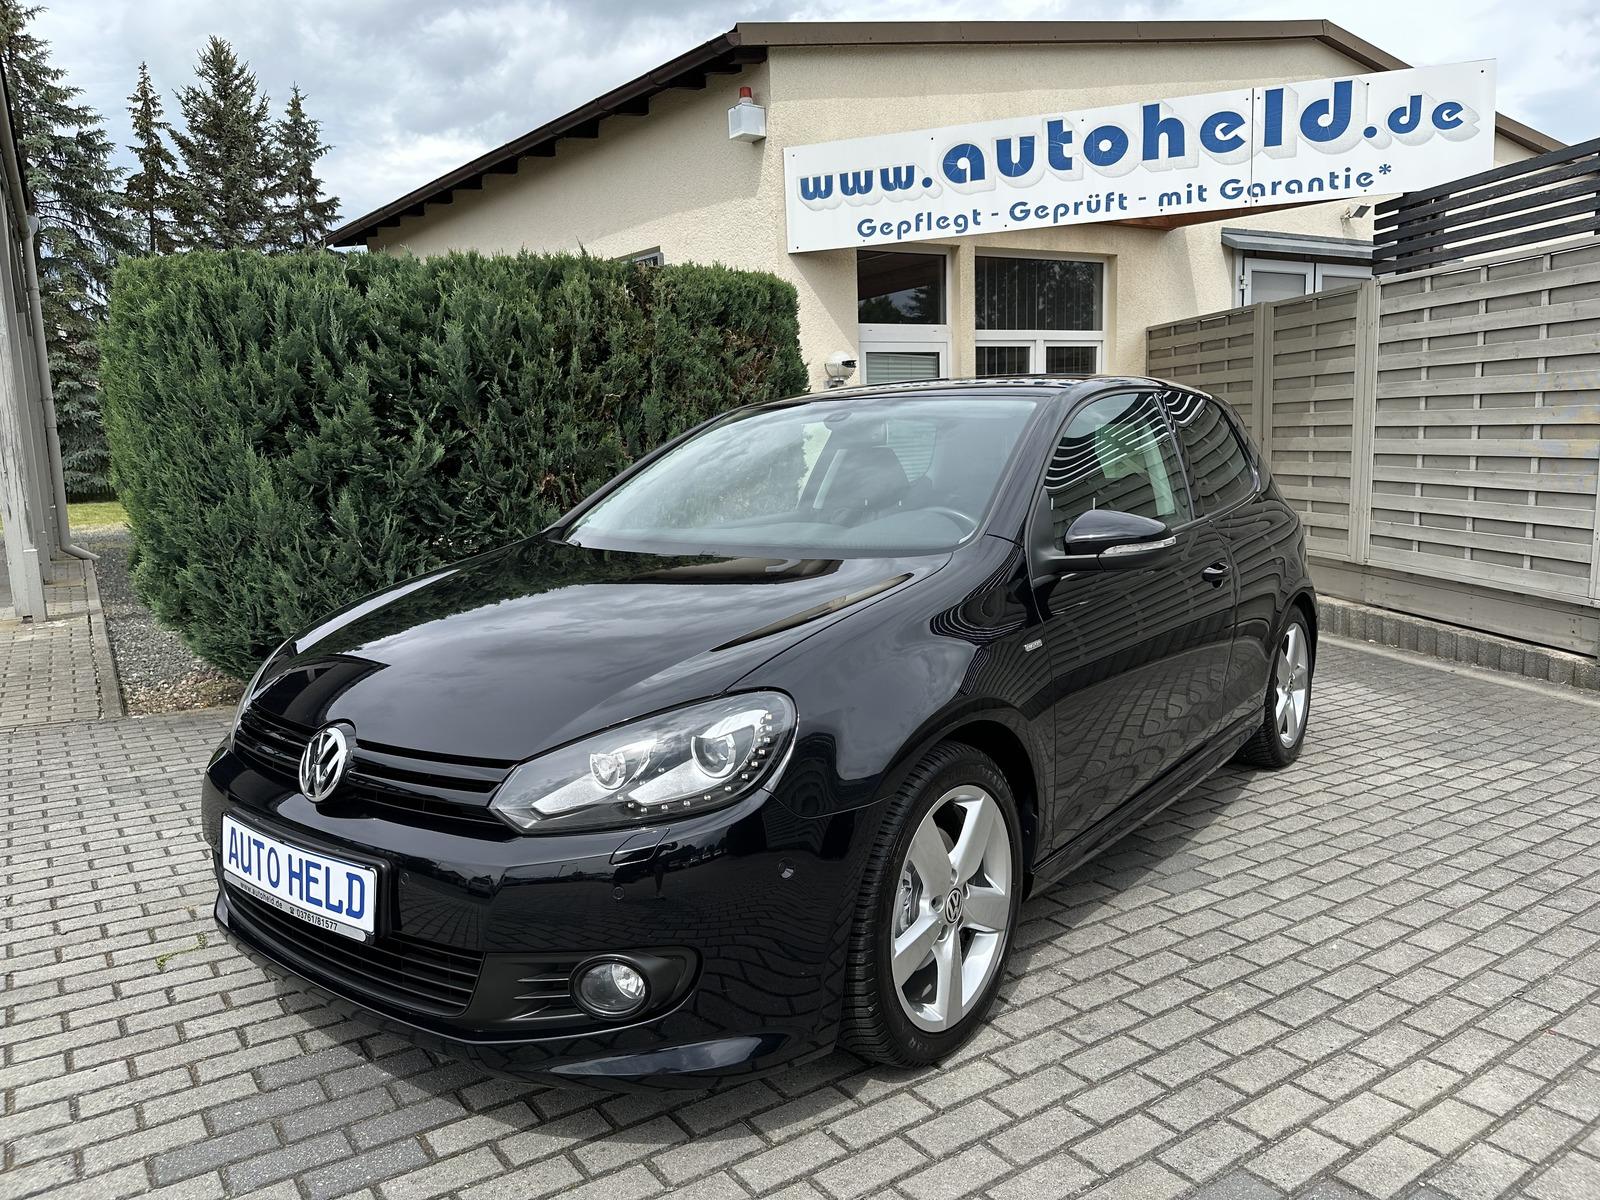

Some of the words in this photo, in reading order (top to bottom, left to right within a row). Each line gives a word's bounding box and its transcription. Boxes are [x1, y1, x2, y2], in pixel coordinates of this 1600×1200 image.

[800, 80, 1464, 200] www.autoheld.de
[857, 209, 981, 239] Gepflegt
[1009, 191, 1128, 223] Geprüft
[1158, 183, 1207, 207] mit
[228, 826, 280, 889] AUTO
[288, 853, 366, 920] HELD
[240, 882, 283, 909] www.autoheld.de
[296, 911, 338, 931] 03761/81577
